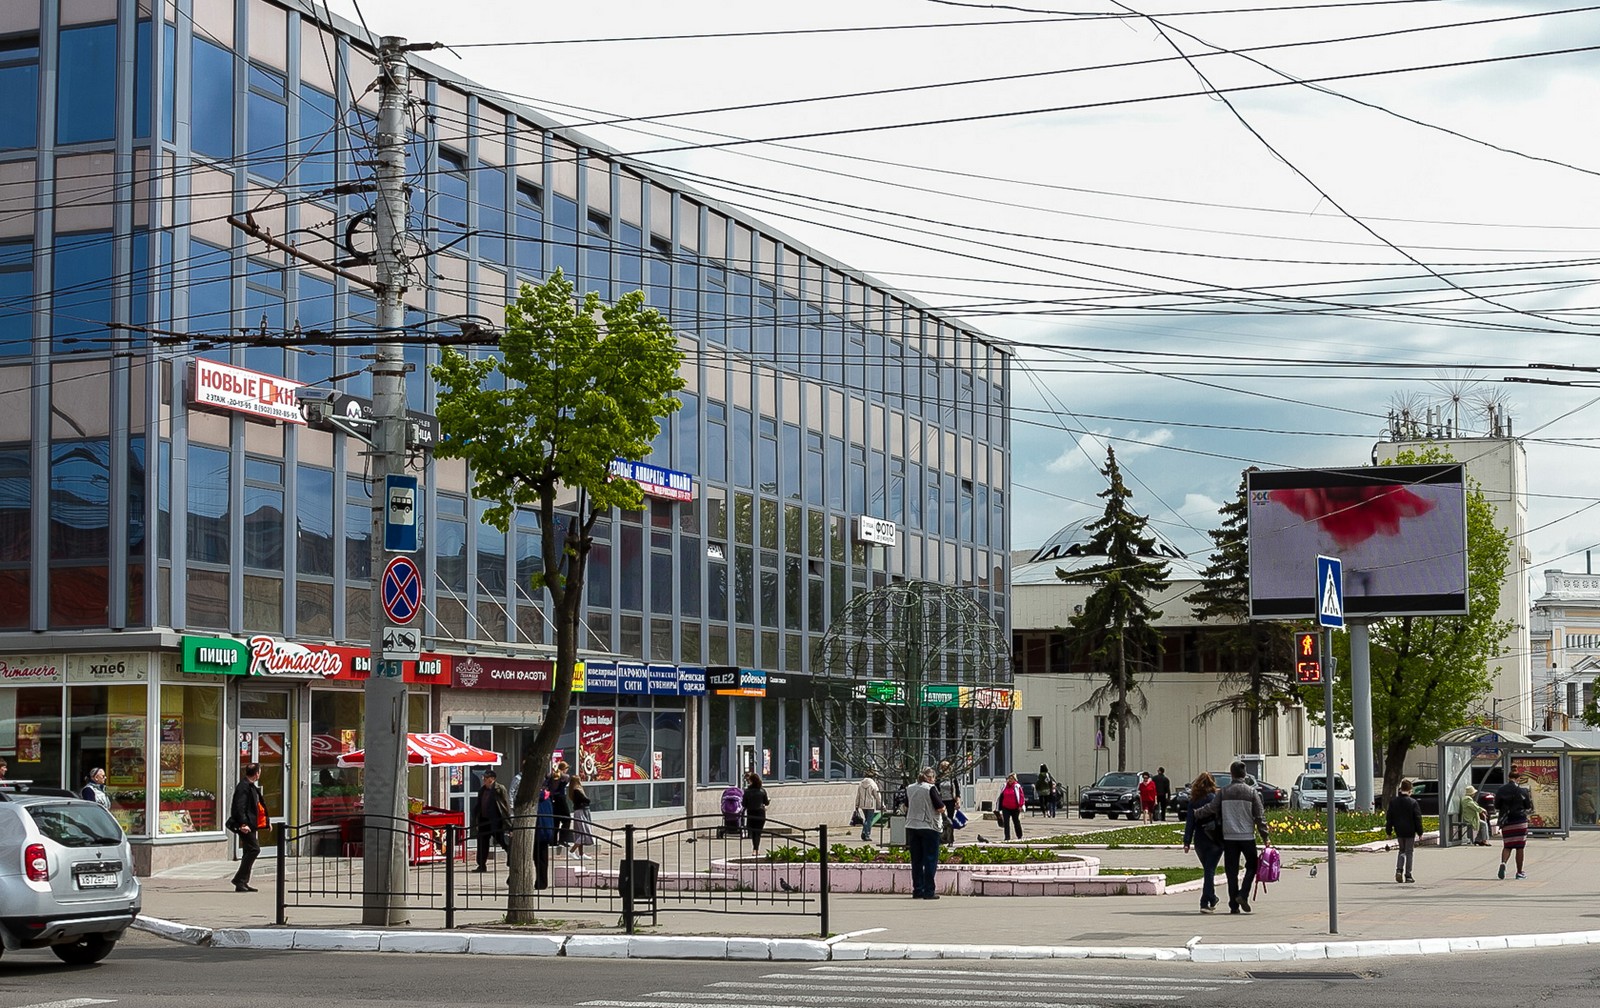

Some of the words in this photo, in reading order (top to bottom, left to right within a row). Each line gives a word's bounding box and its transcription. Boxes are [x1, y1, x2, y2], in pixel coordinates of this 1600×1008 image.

[201, 368, 256, 397] НОВЫЕ
[876, 521, 894, 537] ФОТО
[200, 647, 238, 665] пицца
[251, 636, 342, 674] Primavera
[90, 661, 125, 675] хлеб
[491, 669, 515, 680] САЛОН
[517, 670, 547, 681] КРАСОТЫ
[618, 667, 648, 678] ПАРФЮМ
[1298, 662, 1319, 681] 53
[624, 680, 643, 691] СИТИ
[710, 673, 735, 684] TELE2
[740, 671, 766, 686] роденьги
